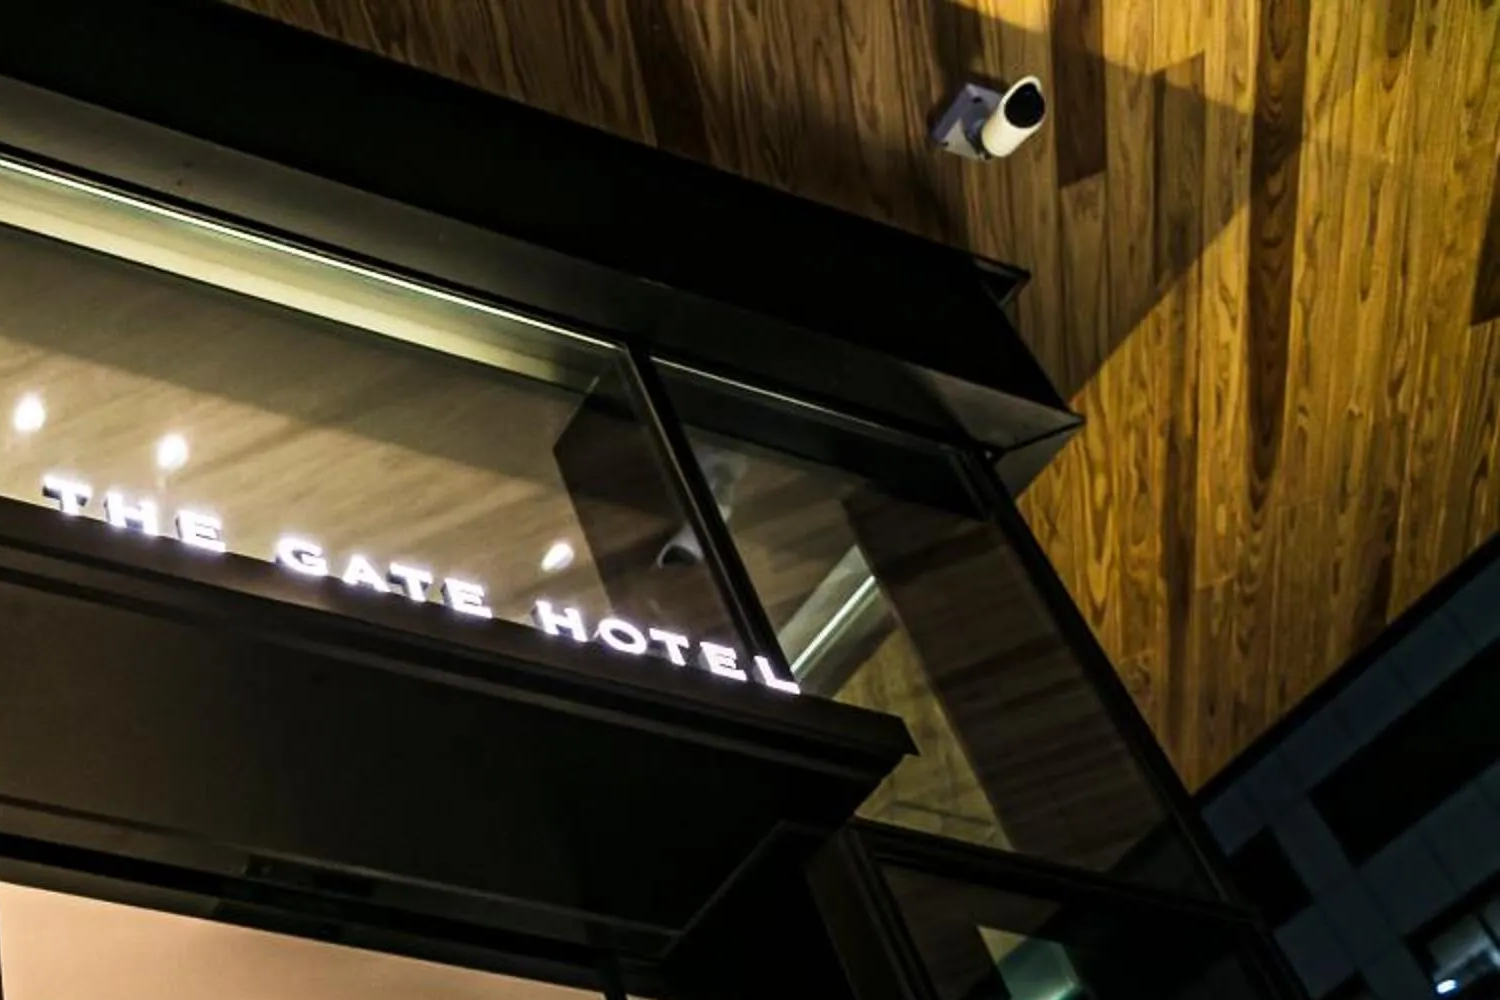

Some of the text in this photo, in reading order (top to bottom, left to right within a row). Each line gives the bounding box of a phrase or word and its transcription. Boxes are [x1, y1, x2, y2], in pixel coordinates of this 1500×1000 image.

[43, 474, 803, 695] THE GATE HOTEL
